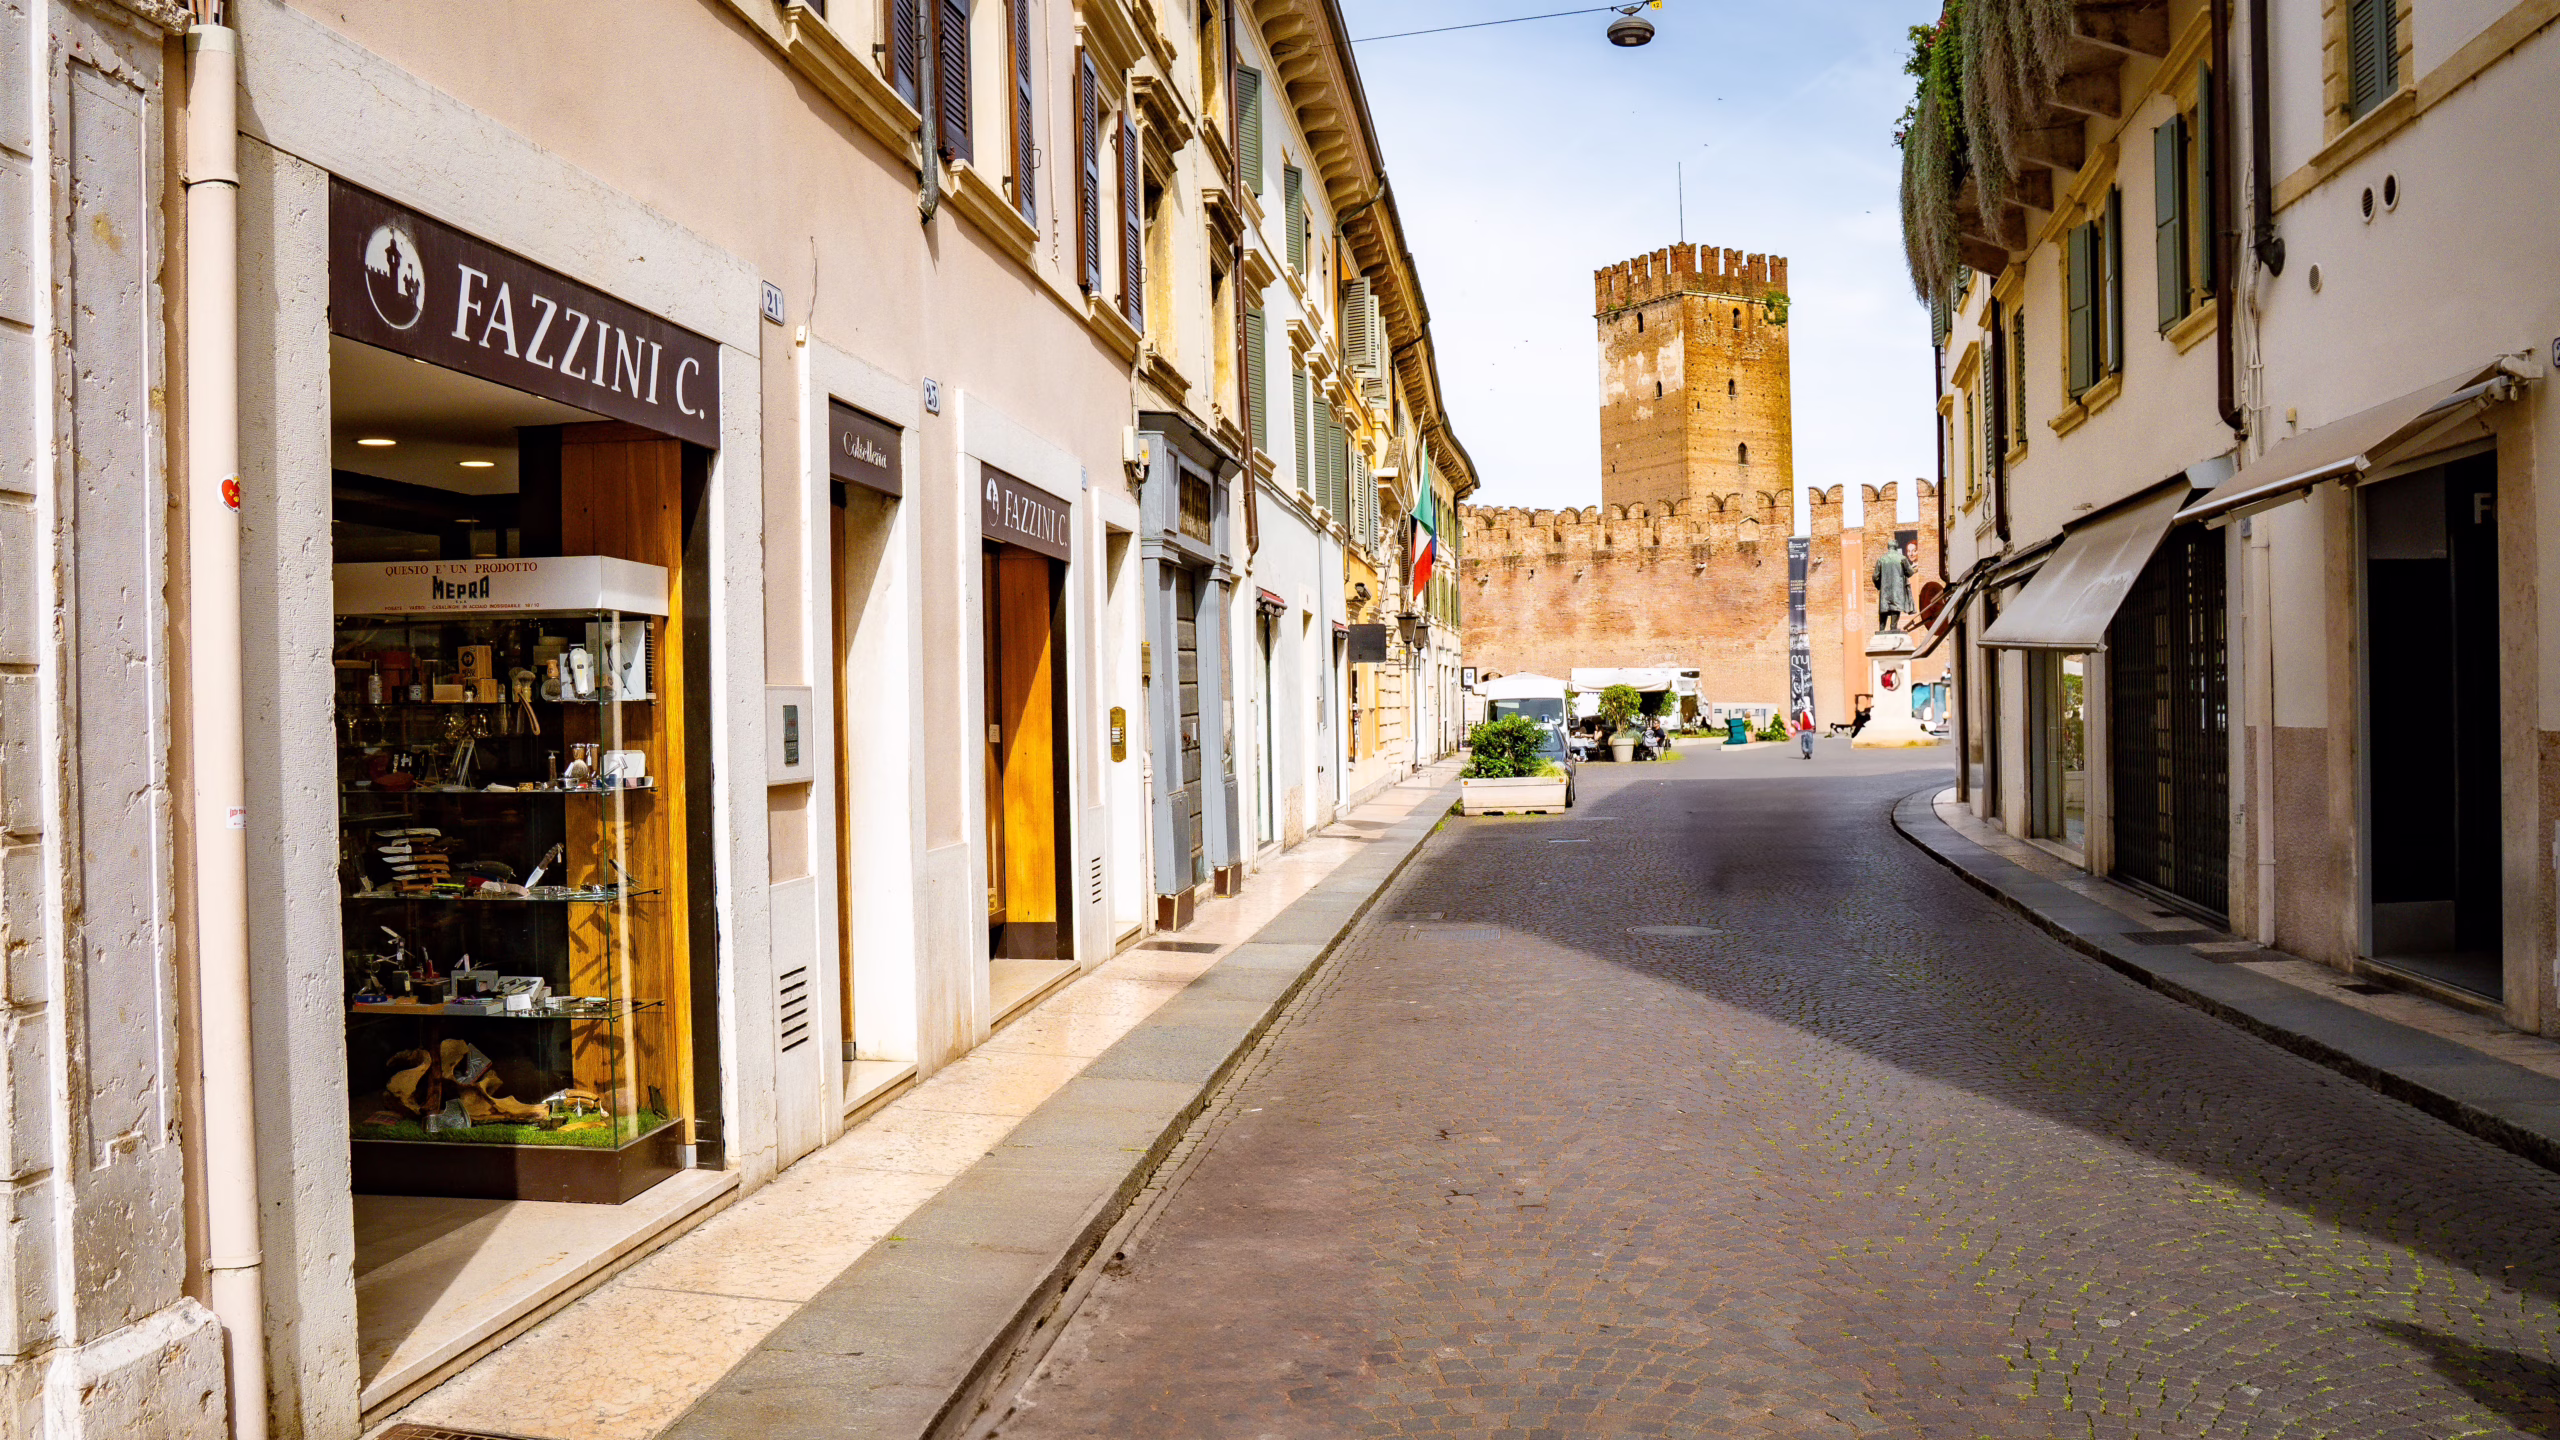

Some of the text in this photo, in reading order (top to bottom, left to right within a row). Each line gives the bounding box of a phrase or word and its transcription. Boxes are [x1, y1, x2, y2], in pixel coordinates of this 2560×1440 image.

[451, 263, 705, 420] FAZZINI C.
[1004, 489, 1068, 547] FAZZINI C.
[385, 564, 429, 577] QUESTO
[450, 564, 467, 574] UN
[475, 561, 538, 574] PRODOTTO
[432, 574, 490, 600] MEPRA
